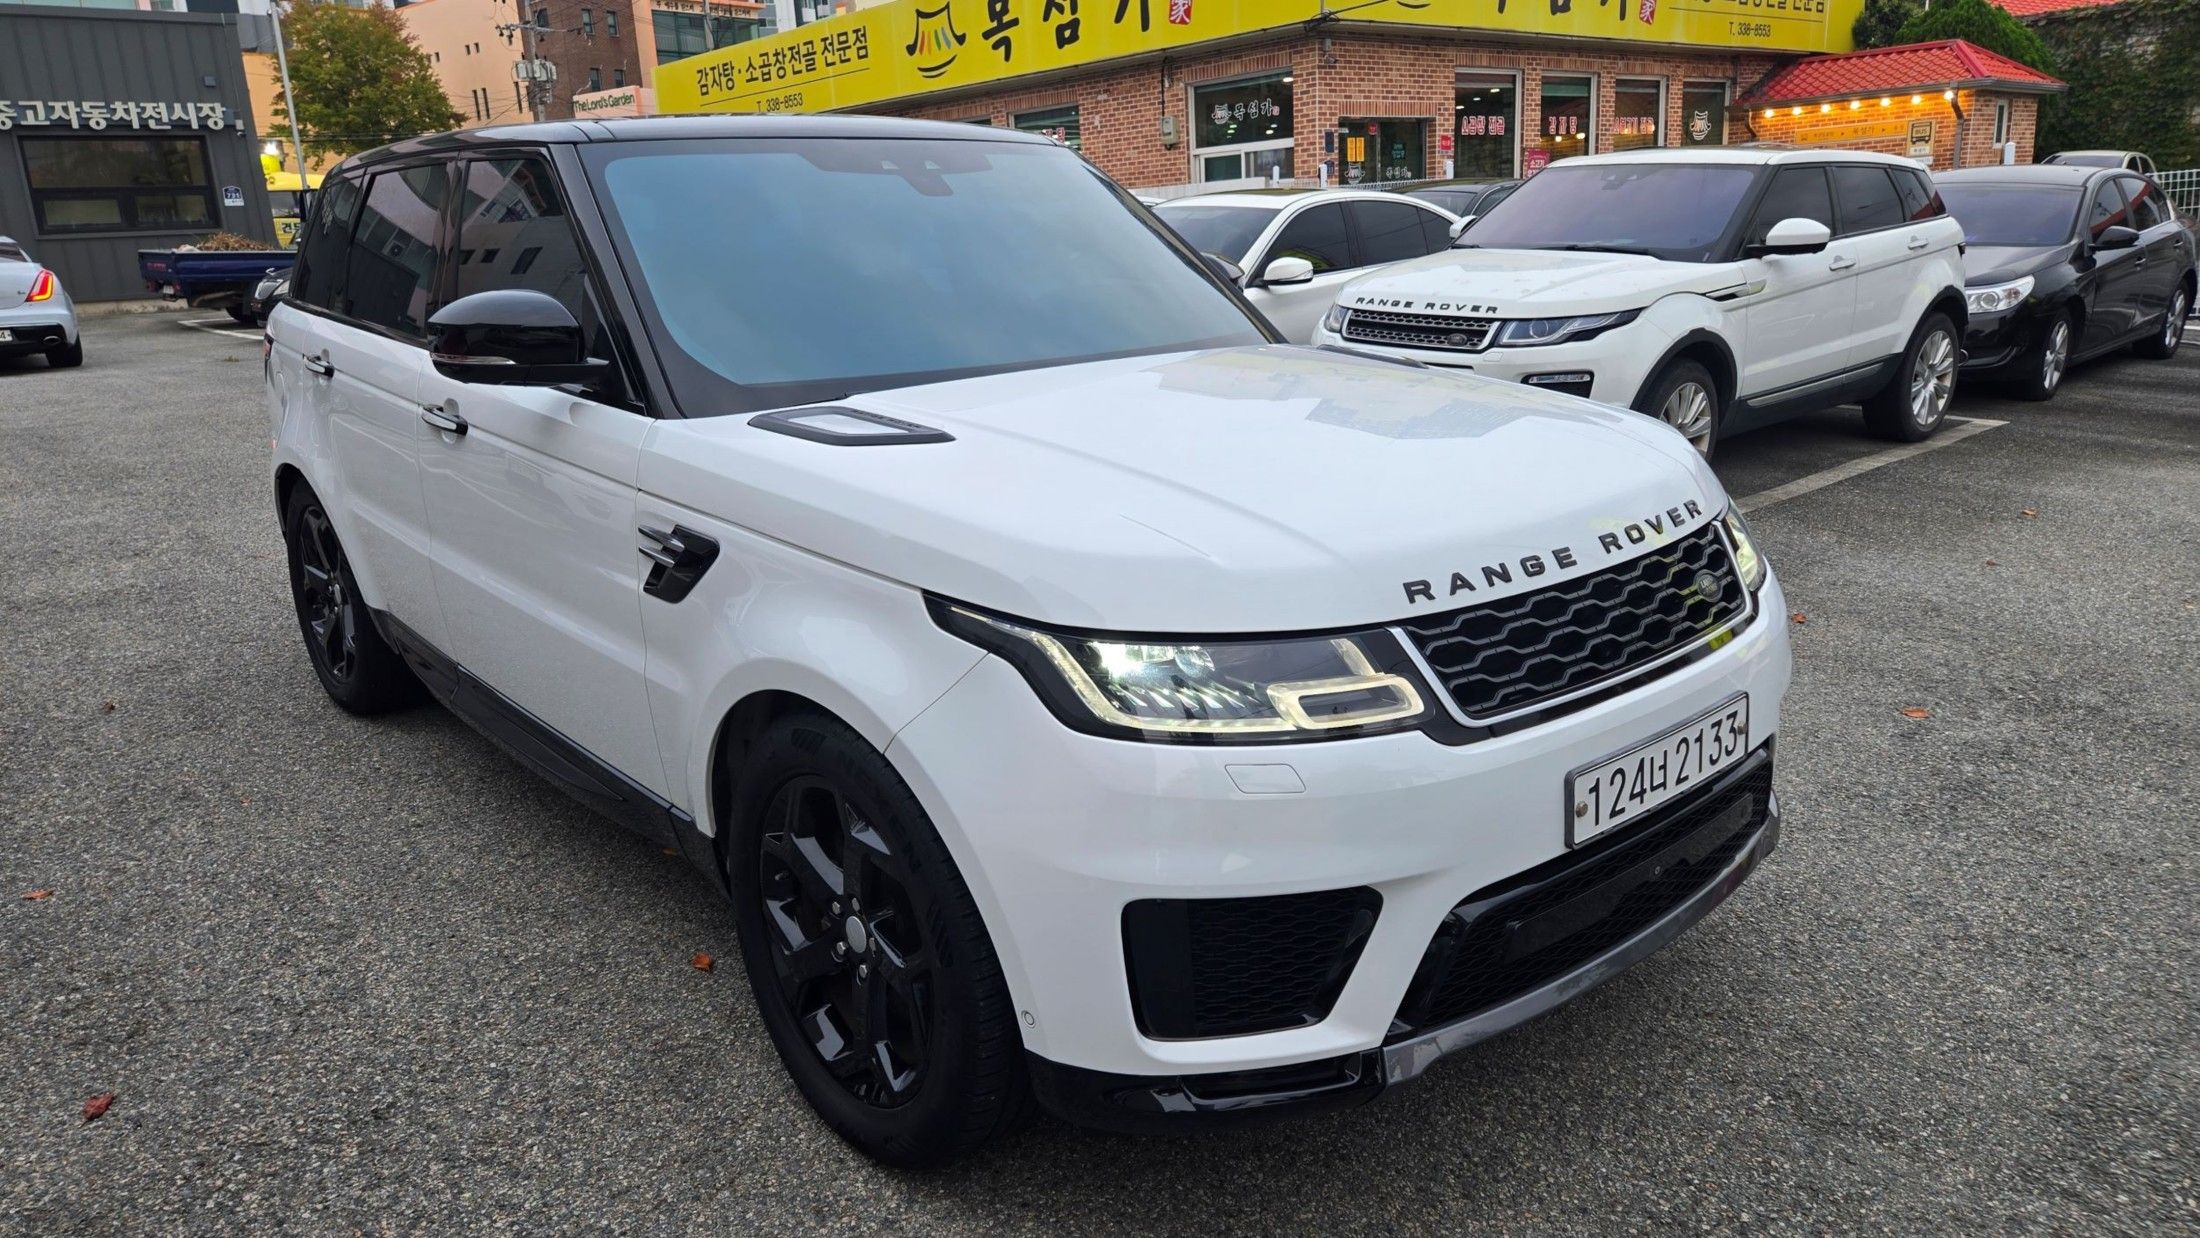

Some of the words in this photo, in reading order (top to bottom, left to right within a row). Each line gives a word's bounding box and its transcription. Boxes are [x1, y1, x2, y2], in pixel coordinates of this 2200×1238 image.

[1737, 22, 1771, 37] 338-8553
[697, 60, 735, 96] 감자탕
[745, 39, 817, 83] 소곱창전골
[820, 25, 868, 67] 전문점
[608, 92, 635, 107] Garden
[766, 92, 803, 112] 338-8553
[0, 100, 226, 130] 중고자동차전시장
[1548, 116, 1577, 134] 감자탕
[1355, 297, 1415, 309] RANGE
[1424, 302, 1498, 314] ROVER
[1403, 546, 1578, 605] RANGE
[1598, 499, 1702, 554] ROVER
[1589, 749, 1668, 826] 124너
[1675, 710, 1739, 786] 2133
